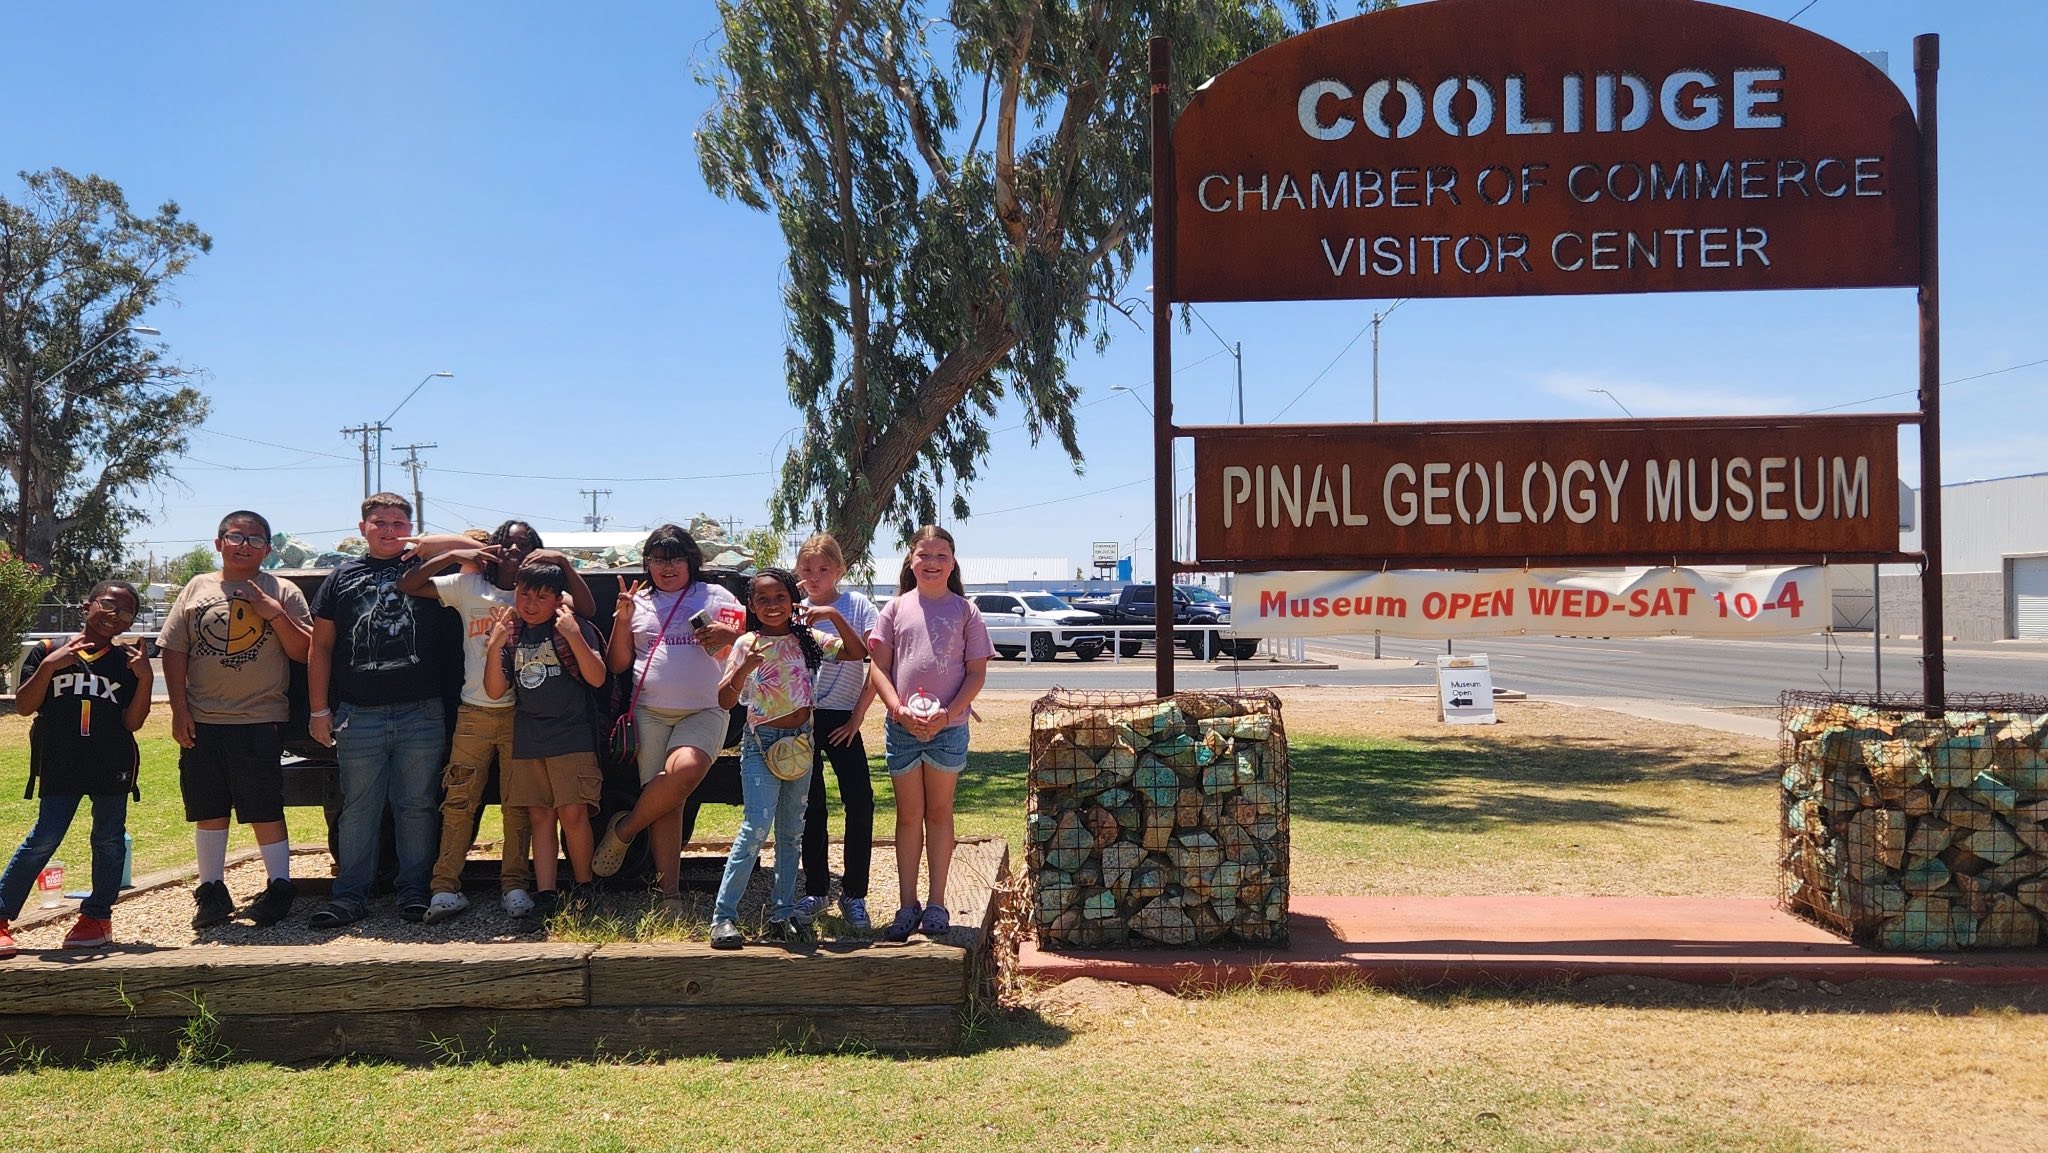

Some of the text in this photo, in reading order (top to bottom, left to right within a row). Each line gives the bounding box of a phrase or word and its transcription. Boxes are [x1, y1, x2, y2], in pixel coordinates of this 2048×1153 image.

[1297, 66, 1786, 141] COOLIDGE
[1198, 157, 1885, 213] CHAMBER OF COMMERCE
[1320, 226, 1772, 277] VISITOR CENTER
[1223, 456, 1870, 528] PINAL GEOLOGY MUSEUM
[1259, 582, 1804, 620] Museum OPEN WED-SAT 10-4
[52, 672, 122, 704] PHX
[1452, 689, 1472, 697] Open
[80, 699, 91, 736] 1
